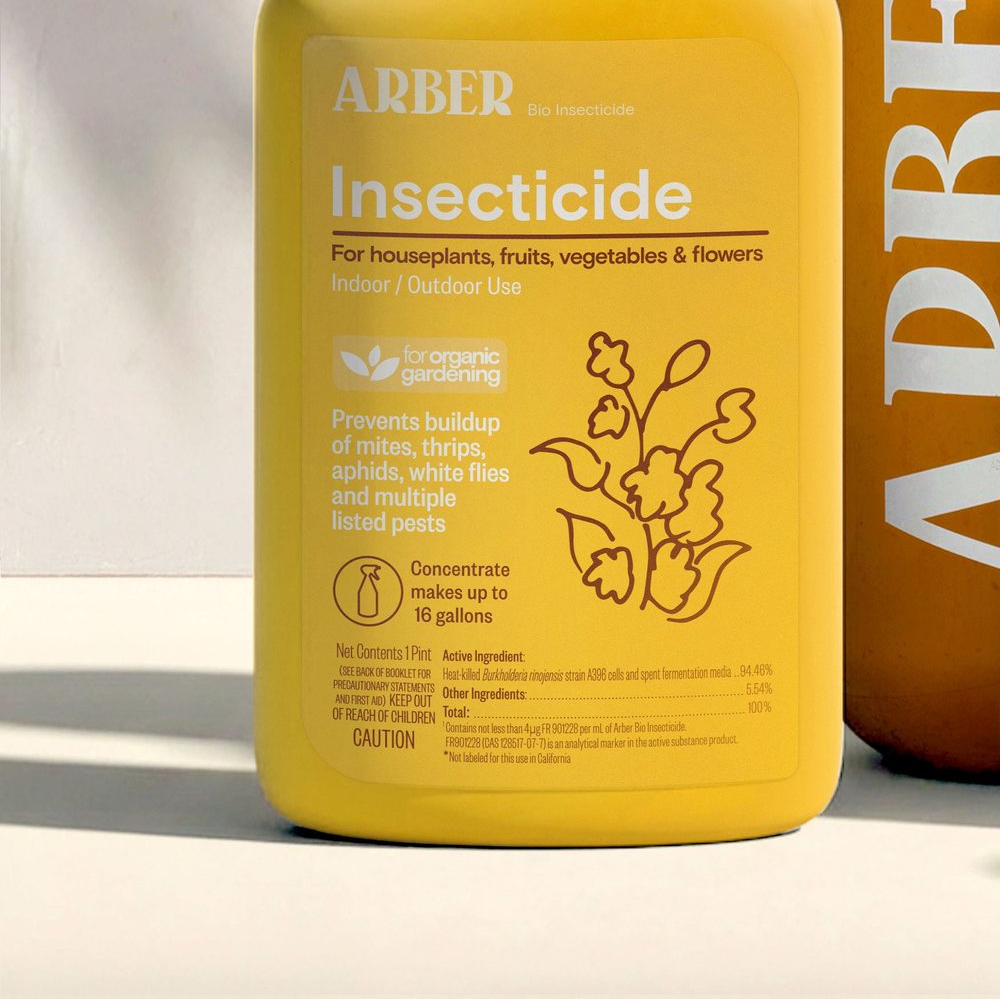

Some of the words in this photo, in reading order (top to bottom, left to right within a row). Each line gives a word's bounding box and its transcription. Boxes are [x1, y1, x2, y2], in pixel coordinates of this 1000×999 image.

[332, 66, 513, 116] ARBER
[528, 103, 551, 116] Bio
[555, 103, 635, 116] Insecticide
[332, 165, 692, 221] Insecticide
[331, 244, 364, 262] For
[371, 246, 495, 268] houseplants,
[500, 247, 554, 267] fruits,
[559, 247, 667, 269] vegetables
[673, 247, 686, 264] &
[692, 244, 763, 263] flowers
[331, 273, 390, 293] Indoor
[395, 274, 403, 295] /
[407, 275, 482, 295] Outdoor
[488, 276, 522, 296] Use
[404, 345, 428, 363] for
[429, 347, 500, 368] organic
[401, 365, 500, 387] gardening
[332, 408, 419, 431] Prevents
[425, 411, 500, 436] buildup
[332, 435, 351, 454] of
[357, 438, 417, 458] mites,
[422, 438, 486, 460] thrips,
[332, 461, 404, 484] aphids,
[409, 463, 463, 482] white
[469, 463, 509, 482] flies
[332, 487, 369, 506] and
[375, 488, 456, 510] multiple
[332, 510, 386, 532] listed
[392, 513, 446, 536] pests
[411, 560, 510, 577] Concentrate
[411, 584, 463, 599] makes
[467, 586, 487, 603] up
[491, 585, 508, 600] to
[415, 607, 432, 622] 16
[436, 608, 493, 627] gallons
[336, 642, 354, 659] Net
[357, 643, 403, 661] Contents
[405, 646, 409, 660] 1
[411, 645, 432, 661] Pint
[442, 650, 472, 662] Active
[339, 666, 355, 676] (SEE
[356, 667, 373, 677] BACK
[375, 668, 384, 678] OF
[385, 668, 417, 678] BOOKLET
[418, 669, 431, 679] FOR
[443, 668, 480, 681] Heat-killed
[482, 668, 527, 681] Burkholderia
[565, 669, 585, 681] strain
[587, 668, 606, 681] A396
[608, 668, 624, 681] cells
[625, 668, 639, 681] and
[641, 667, 660, 683] spent
[662, 667, 708, 679] fermentation
[710, 665, 732, 678] media
[333, 680, 389, 691] PRECAUTIONARY
[390, 682, 435, 693] STATEMENTS
[442, 687, 468, 699] Other
[746, 683, 773, 696] 5.54%
[336, 694, 350, 705] AND
[351, 695, 370, 705] FIRST
[371, 695, 386, 707] AID)
[389, 693, 412, 707] KEEP
[414, 694, 432, 708] OUT
[332, 707, 343, 720] OF
[346, 708, 376, 722] REACH
[378, 709, 389, 722] OF
[391, 710, 435, 724] CHILDREN
[443, 706, 470, 718] Total:
[353, 727, 415, 749] CAUTION
